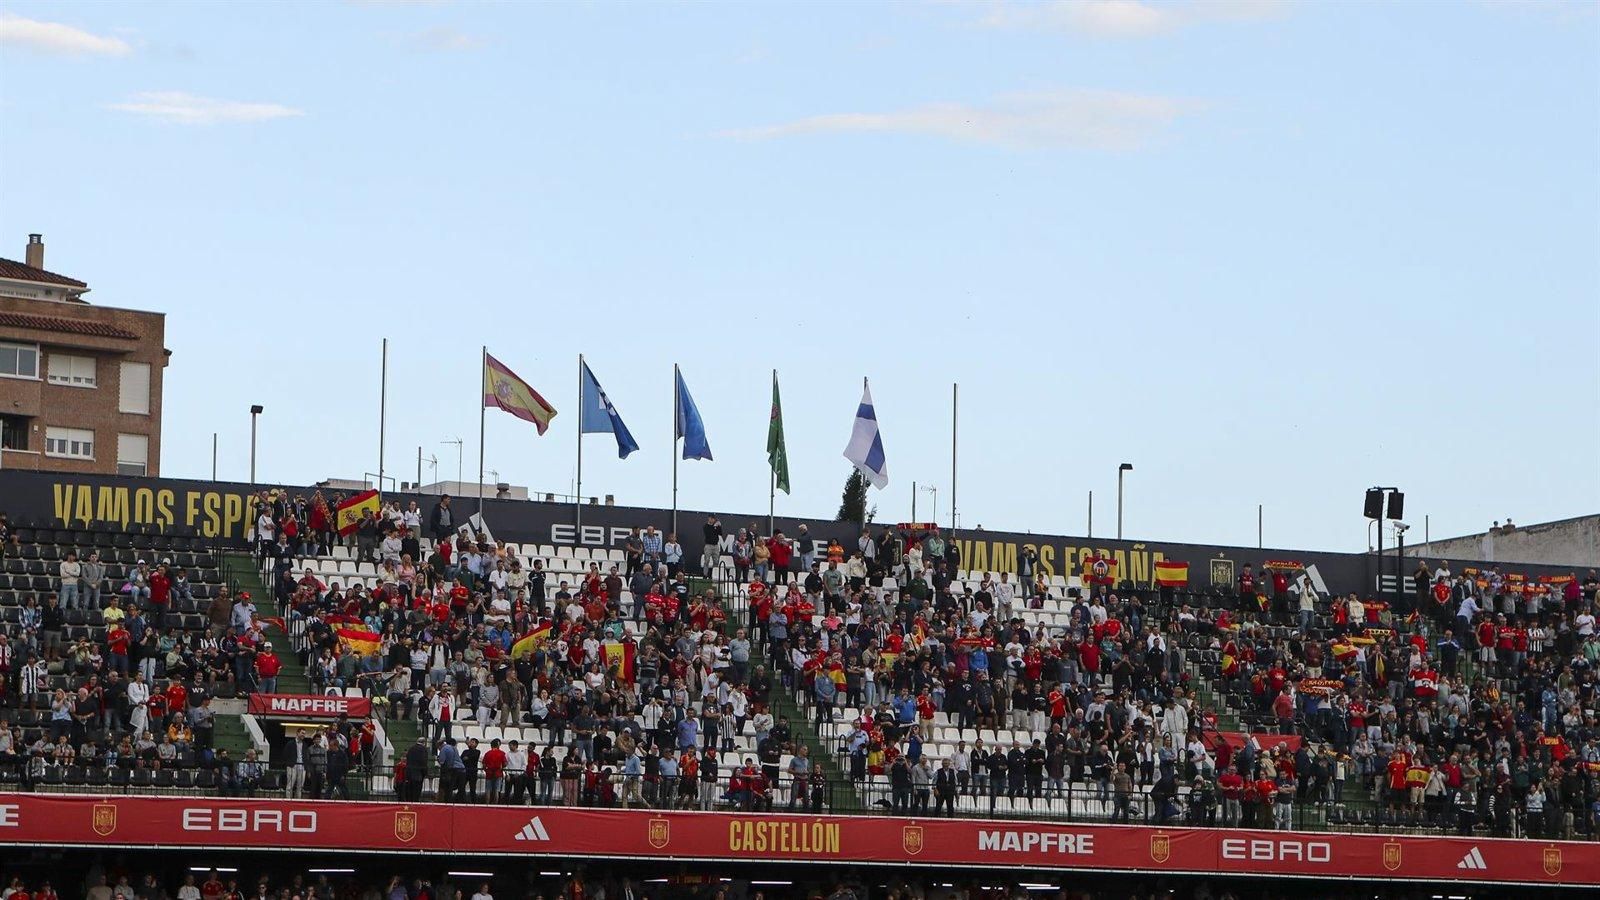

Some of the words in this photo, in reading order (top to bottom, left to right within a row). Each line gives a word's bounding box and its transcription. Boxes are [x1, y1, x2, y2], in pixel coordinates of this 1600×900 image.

[54, 483, 174, 534] VAMOS
[186, 488, 285, 538] ESPA
[272, 698, 348, 713] MAPFRE
[182, 808, 317, 832] EBRO
[729, 818, 840, 853] CASTELLÓN
[978, 830, 1094, 854] MAPFRE
[1222, 838, 1331, 863] EBRO
